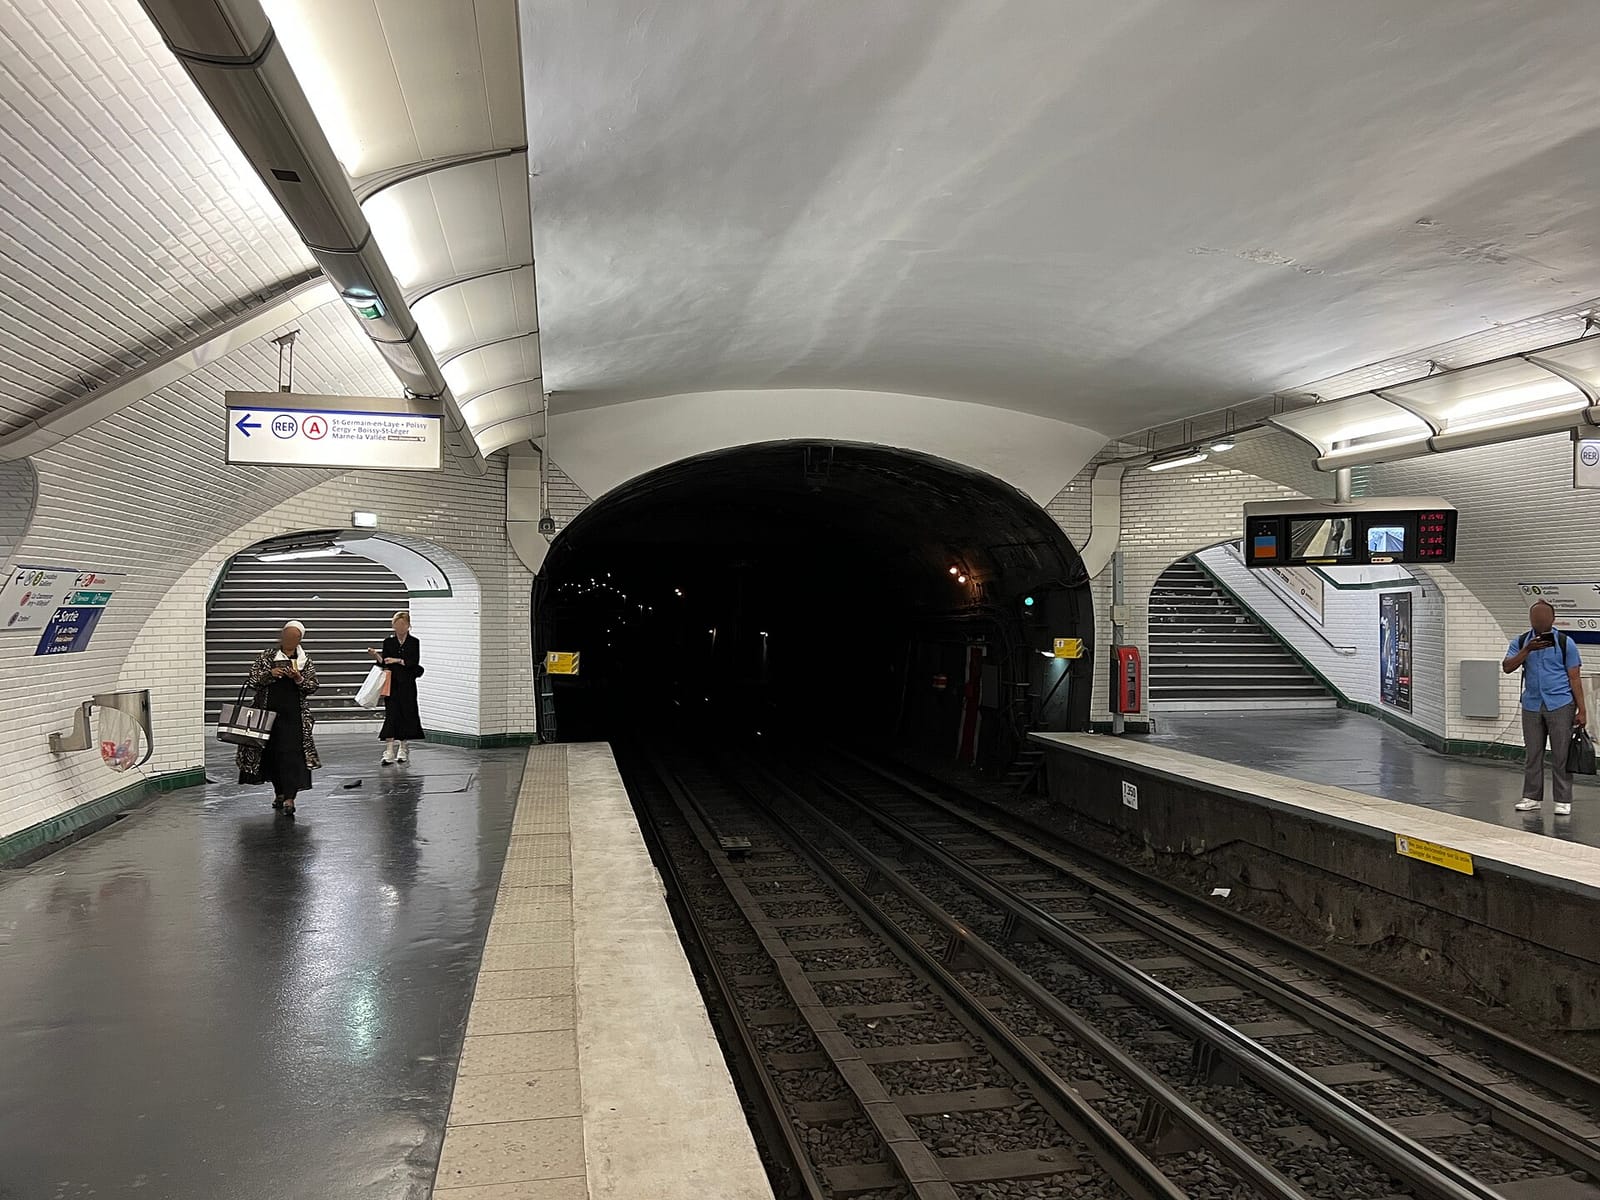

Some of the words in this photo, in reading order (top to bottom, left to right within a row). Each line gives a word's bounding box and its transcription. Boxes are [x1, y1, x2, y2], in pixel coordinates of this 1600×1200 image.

[275, 422, 294, 432] RER
[309, 422, 320, 434] A
[1583, 451, 1597, 460] RER
[59, 610, 79, 622] Sortie
